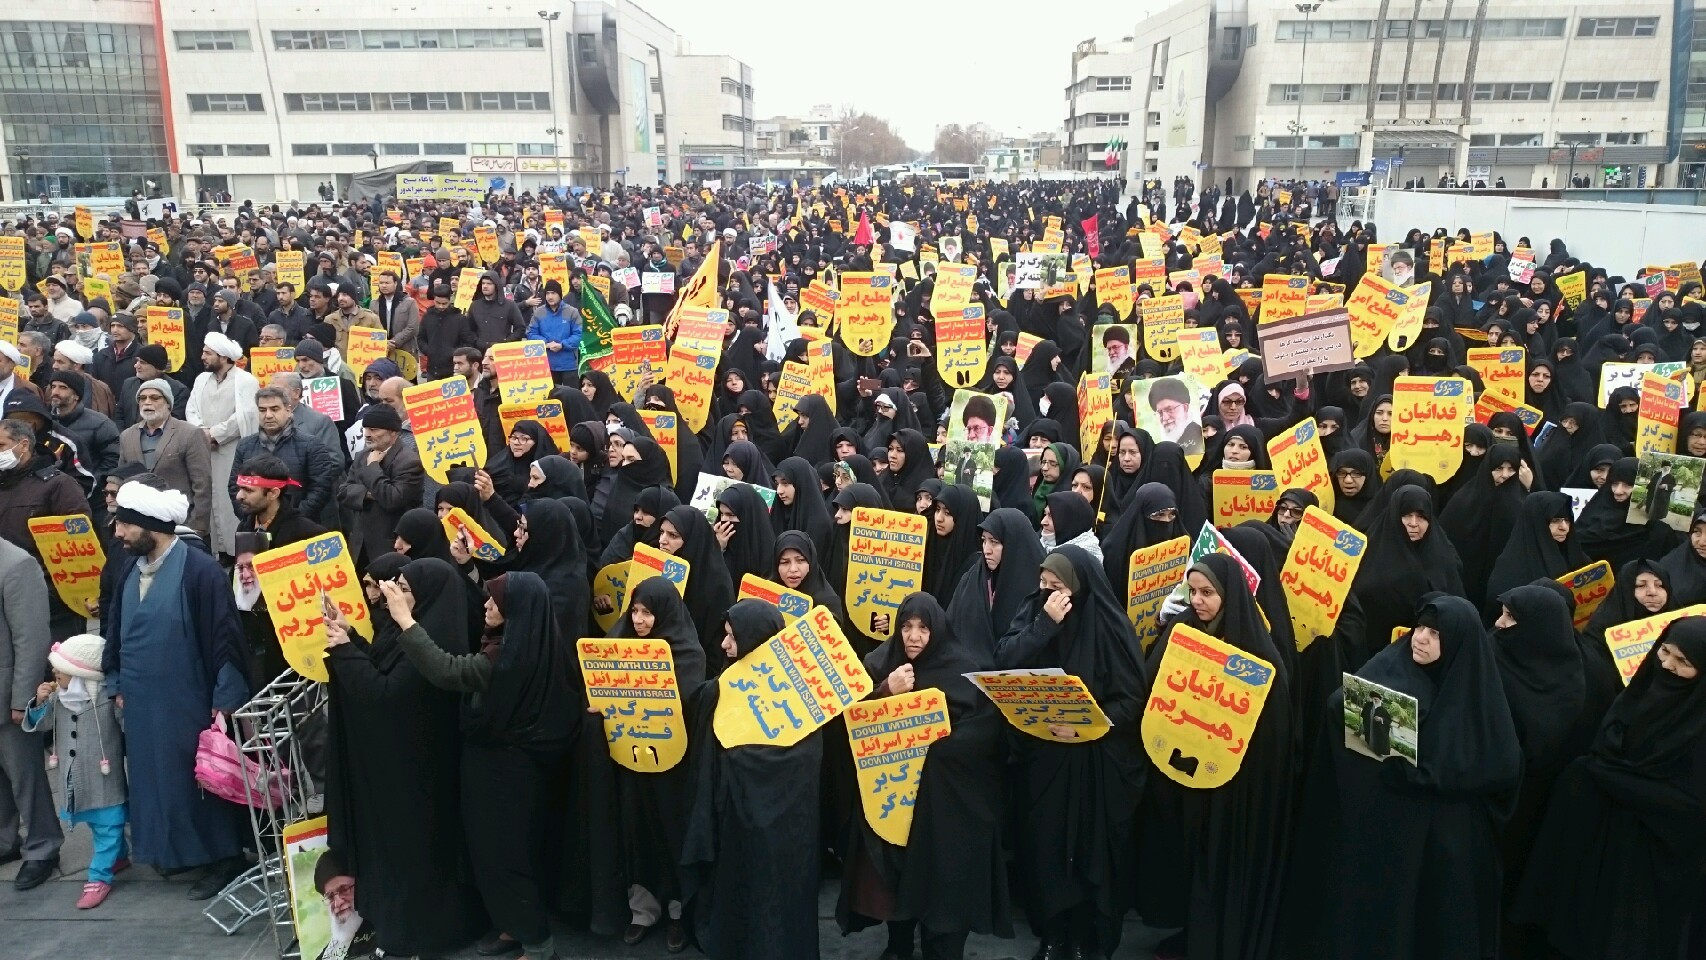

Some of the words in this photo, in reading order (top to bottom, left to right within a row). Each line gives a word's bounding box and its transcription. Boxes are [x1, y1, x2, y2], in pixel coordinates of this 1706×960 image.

[1028, 257, 1041, 269] رگ
[937, 276, 951, 287] امر
[950, 278, 972, 288] مطیع
[1099, 282, 1109, 292] امر
[1110, 277, 1129, 291] مطیع
[843, 291, 859, 307] امر
[860, 291, 890, 306] مطیع
[937, 292, 965, 303] رهبریم
[1265, 290, 1279, 301] امر
[1281, 288, 1305, 300] مطیع
[1351, 294, 1373, 305] امر
[1367, 302, 1399, 320] مطیع
[849, 313, 885, 325] رهبریم
[1349, 313, 1381, 337] رهبریم
[150, 321, 162, 333] امر
[163, 321, 182, 333] مطیع
[363, 338, 386, 352] مطیع
[943, 346, 951, 357] بر
[953, 343, 981, 356] مرگ
[1184, 345, 1195, 359] امر
[1197, 344, 1220, 358] مطیع
[943, 359, 954, 372] گر
[955, 357, 979, 367] فتنه
[668, 366, 685, 380] امر
[685, 370, 712, 385] مطیع
[1489, 365, 1523, 381] مطیع
[507, 386, 516, 397] بر
[517, 382, 548, 395] مرگ
[454, 397, 467, 406] ملت
[1088, 395, 1109, 416] فدائیان
[414, 407, 429, 417] است
[1398, 401, 1457, 423] فدائیان
[414, 422, 429, 430] است
[1642, 425, 1650, 437] بر
[1650, 424, 1673, 441] مرگ
[427, 436, 435, 451] بر
[437, 428, 474, 444] مرگ
[1391, 429, 1460, 447] رهبریم
[445, 441, 476, 460] فتنه
[433, 450, 443, 468] گر
[1281, 443, 1319, 485] فدائیان
[1220, 495, 1275, 517] فدائیان
[856, 510, 885, 526] امریکا
[886, 518, 896, 529] بر
[898, 517, 922, 532] مرگ
[855, 528, 878, 538] DOWN
[880, 531, 899, 540] WITH
[901, 533, 921, 543] U.S.A
[50, 540, 96, 564] فدائیان
[852, 539, 888, 555] اسرائیل
[889, 546, 898, 558] بر
[898, 546, 922, 560] مرگ
[1160, 548, 1167, 561] بر
[1168, 542, 1187, 556] مرگ
[852, 554, 874, 563] DOWN
[876, 557, 893, 566] WITH
[894, 559, 920, 570] ISRAEL
[1135, 548, 1159, 565] امریکا
[1294, 543, 1347, 583] فدائیان
[1134, 568, 1153, 579] DOWN
[1154, 562, 1169, 573] WITH
[1169, 556, 1185, 568] U.S.A
[855, 570, 868, 584] بر
[870, 569, 914, 589] مرگ
[276, 564, 348, 612] فدائیان
[1131, 574, 1160, 597] اسرائیل
[853, 589, 871, 607] گر
[1131, 595, 1150, 606] DOWN
[1151, 589, 1164, 600] WITH
[1280, 570, 1339, 620] رهبریم
[814, 611, 843, 648] امریکا
[1610, 621, 1654, 642] امریکا
[582, 643, 619, 658] امریکا
[622, 647, 632, 658] بر
[636, 643, 666, 659] مرگ
[781, 633, 817, 673] اسرائیل
[831, 652, 847, 663] بر
[586, 661, 615, 669] DOWN
[617, 661, 641, 669] WITH
[643, 662, 667, 670] U.S.A
[751, 662, 774, 677] بر
[800, 624, 818, 652] DOWN
[816, 654, 834, 677] WITH
[831, 677, 849, 703] U.S.A
[587, 671, 630, 687] اسرائیل
[634, 676, 642, 687] بر
[645, 674, 674, 688] مرگ
[729, 678, 759, 692] گر
[772, 641, 790, 669] DOWN
[787, 669, 802, 691] WITH
[801, 690, 823, 721] ISRAEL
[804, 676, 821, 688] بر
[844, 664, 865, 692] مرگ
[981, 677, 1022, 685] امریکا
[619, 689, 641, 697] WITH
[643, 690, 674, 698] ISRAEL
[1167, 666, 1250, 715] فدائیان
[768, 675, 803, 729] مرگ
[816, 685, 837, 715] مرگ
[907, 695, 938, 711] مرگ
[604, 704, 616, 719] بر
[618, 699, 673, 721] مرگ
[747, 694, 784, 739] فتنه
[849, 702, 889, 722] امریکا
[892, 702, 903, 717] بر
[1030, 705, 1091, 715] مرگ
[855, 724, 885, 737] DOWN
[888, 718, 913, 730] WITH
[915, 714, 940, 725] U.S.A
[1023, 716, 1039, 725] گر
[1042, 716, 1093, 725] فتنه
[1150, 695, 1244, 755] رهبریم
[608, 723, 625, 742] گر
[627, 722, 672, 740] فتنه
[857, 732, 901, 757] اسرائیل
[905, 733, 915, 748] بر
[860, 755, 889, 768] DOWN
[892, 750, 913, 761] WITH
[873, 772, 887, 793] بر
[879, 792, 897, 819] گر
